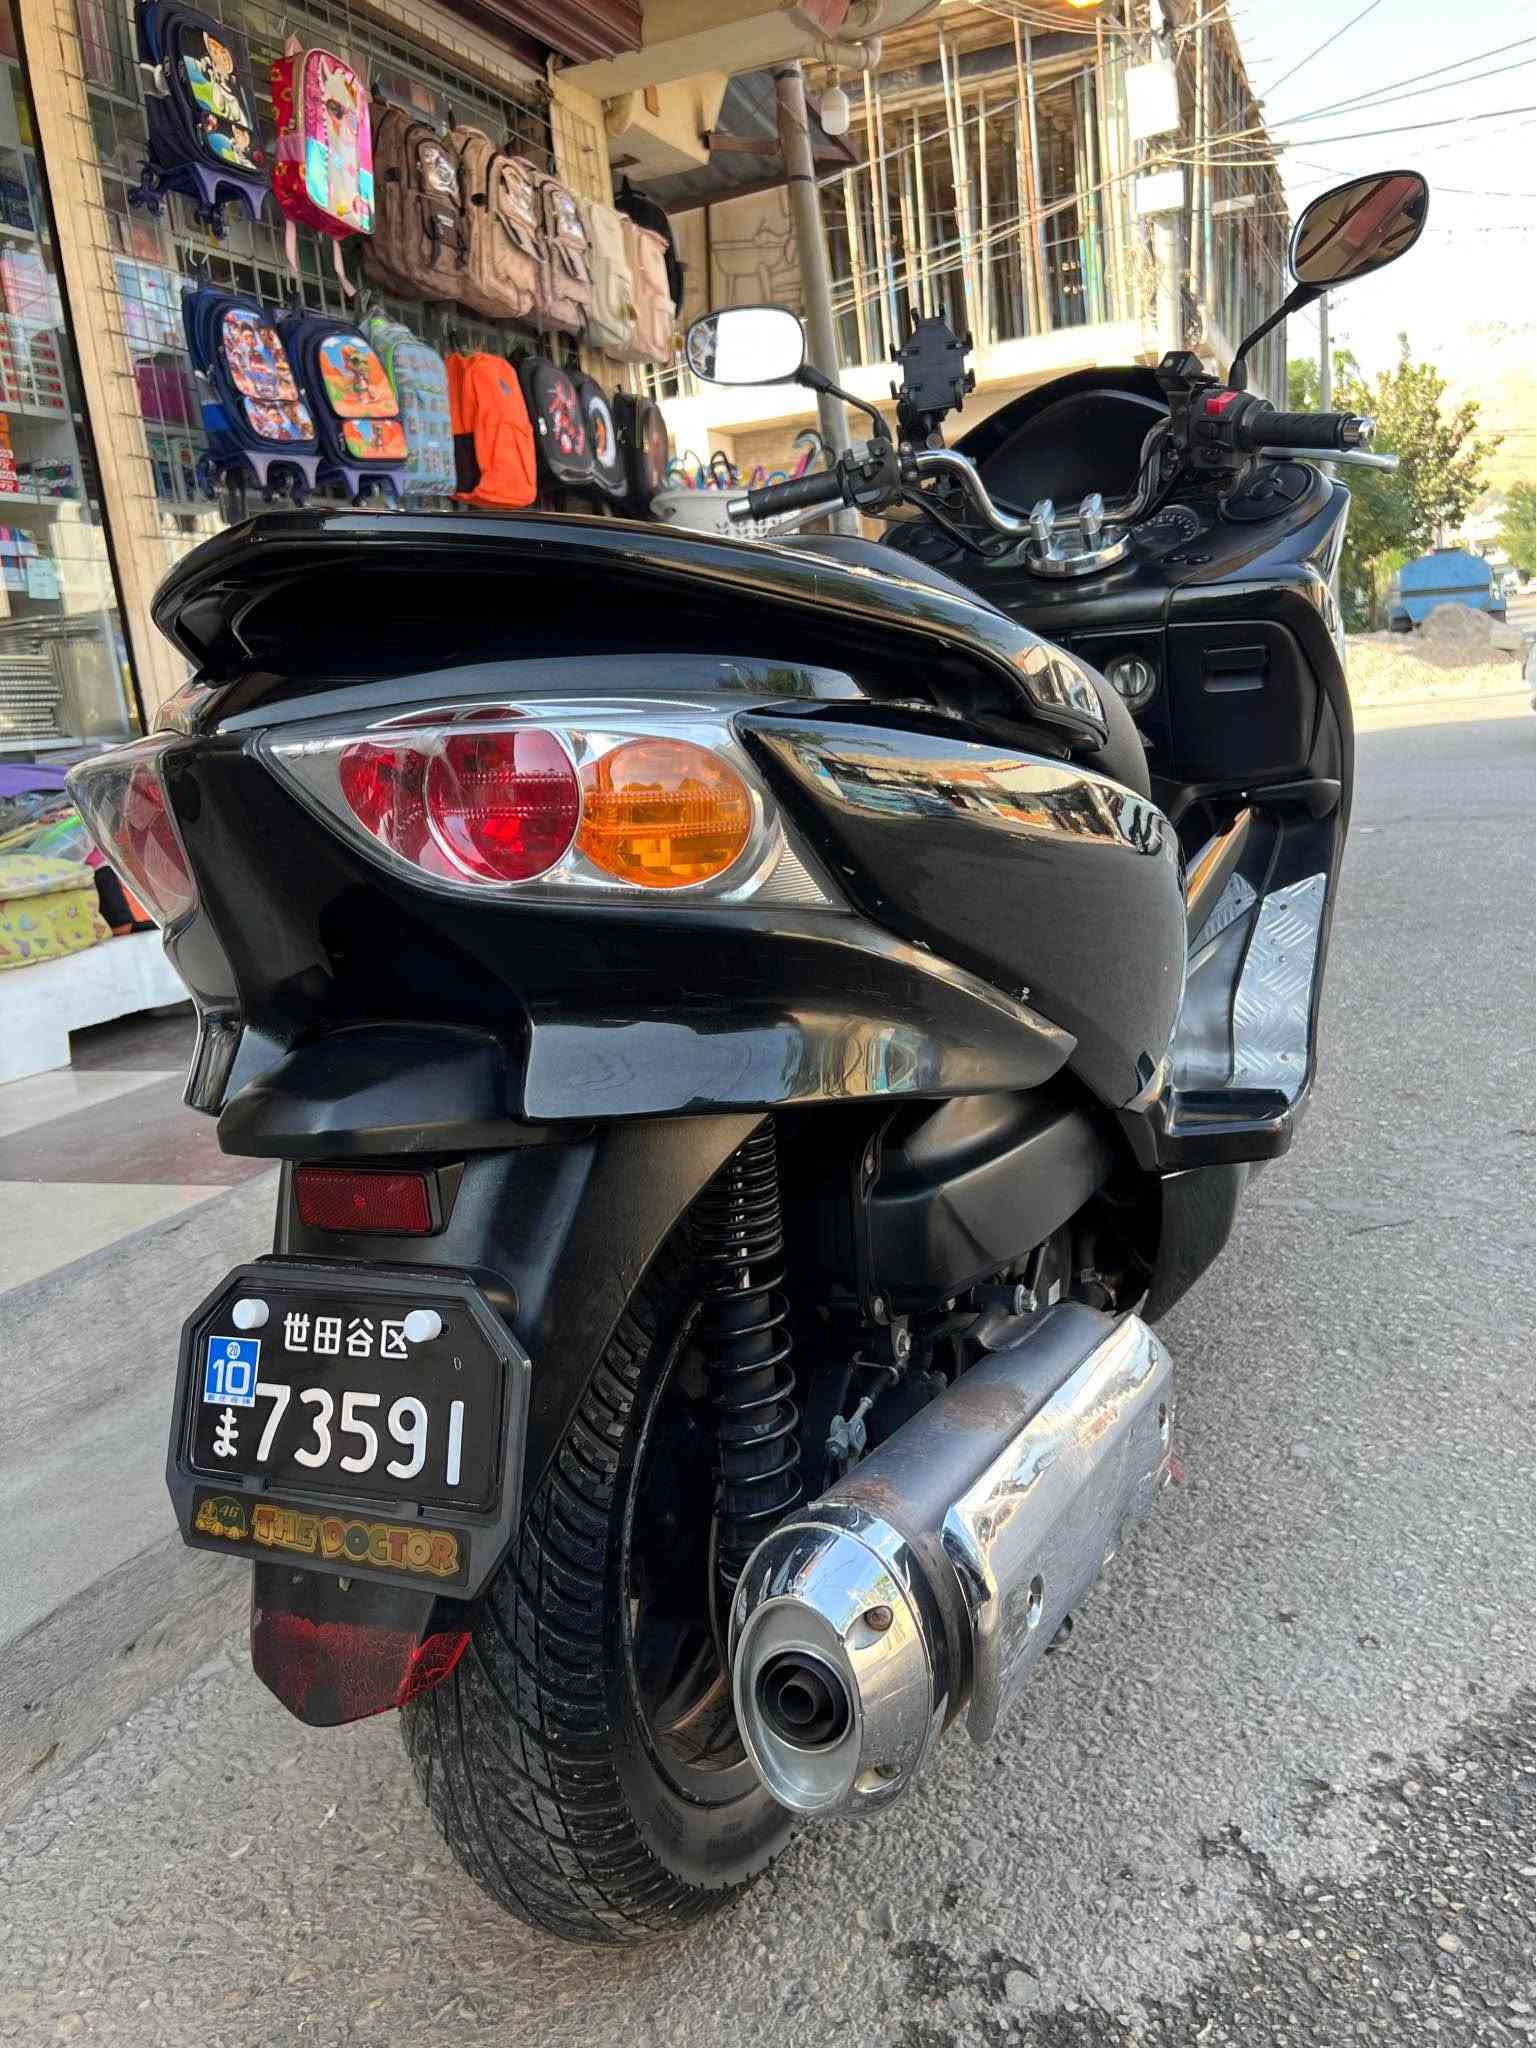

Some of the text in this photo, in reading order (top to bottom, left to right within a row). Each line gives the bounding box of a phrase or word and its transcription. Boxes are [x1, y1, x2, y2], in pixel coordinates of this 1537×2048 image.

[283, 1311, 409, 1359] 世田谷区
[212, 1359, 251, 1395] 10
[212, 1407, 240, 1458] ま
[255, 1382, 465, 1486] 73591
[254, 1504, 460, 1577] THE DOCTOR
